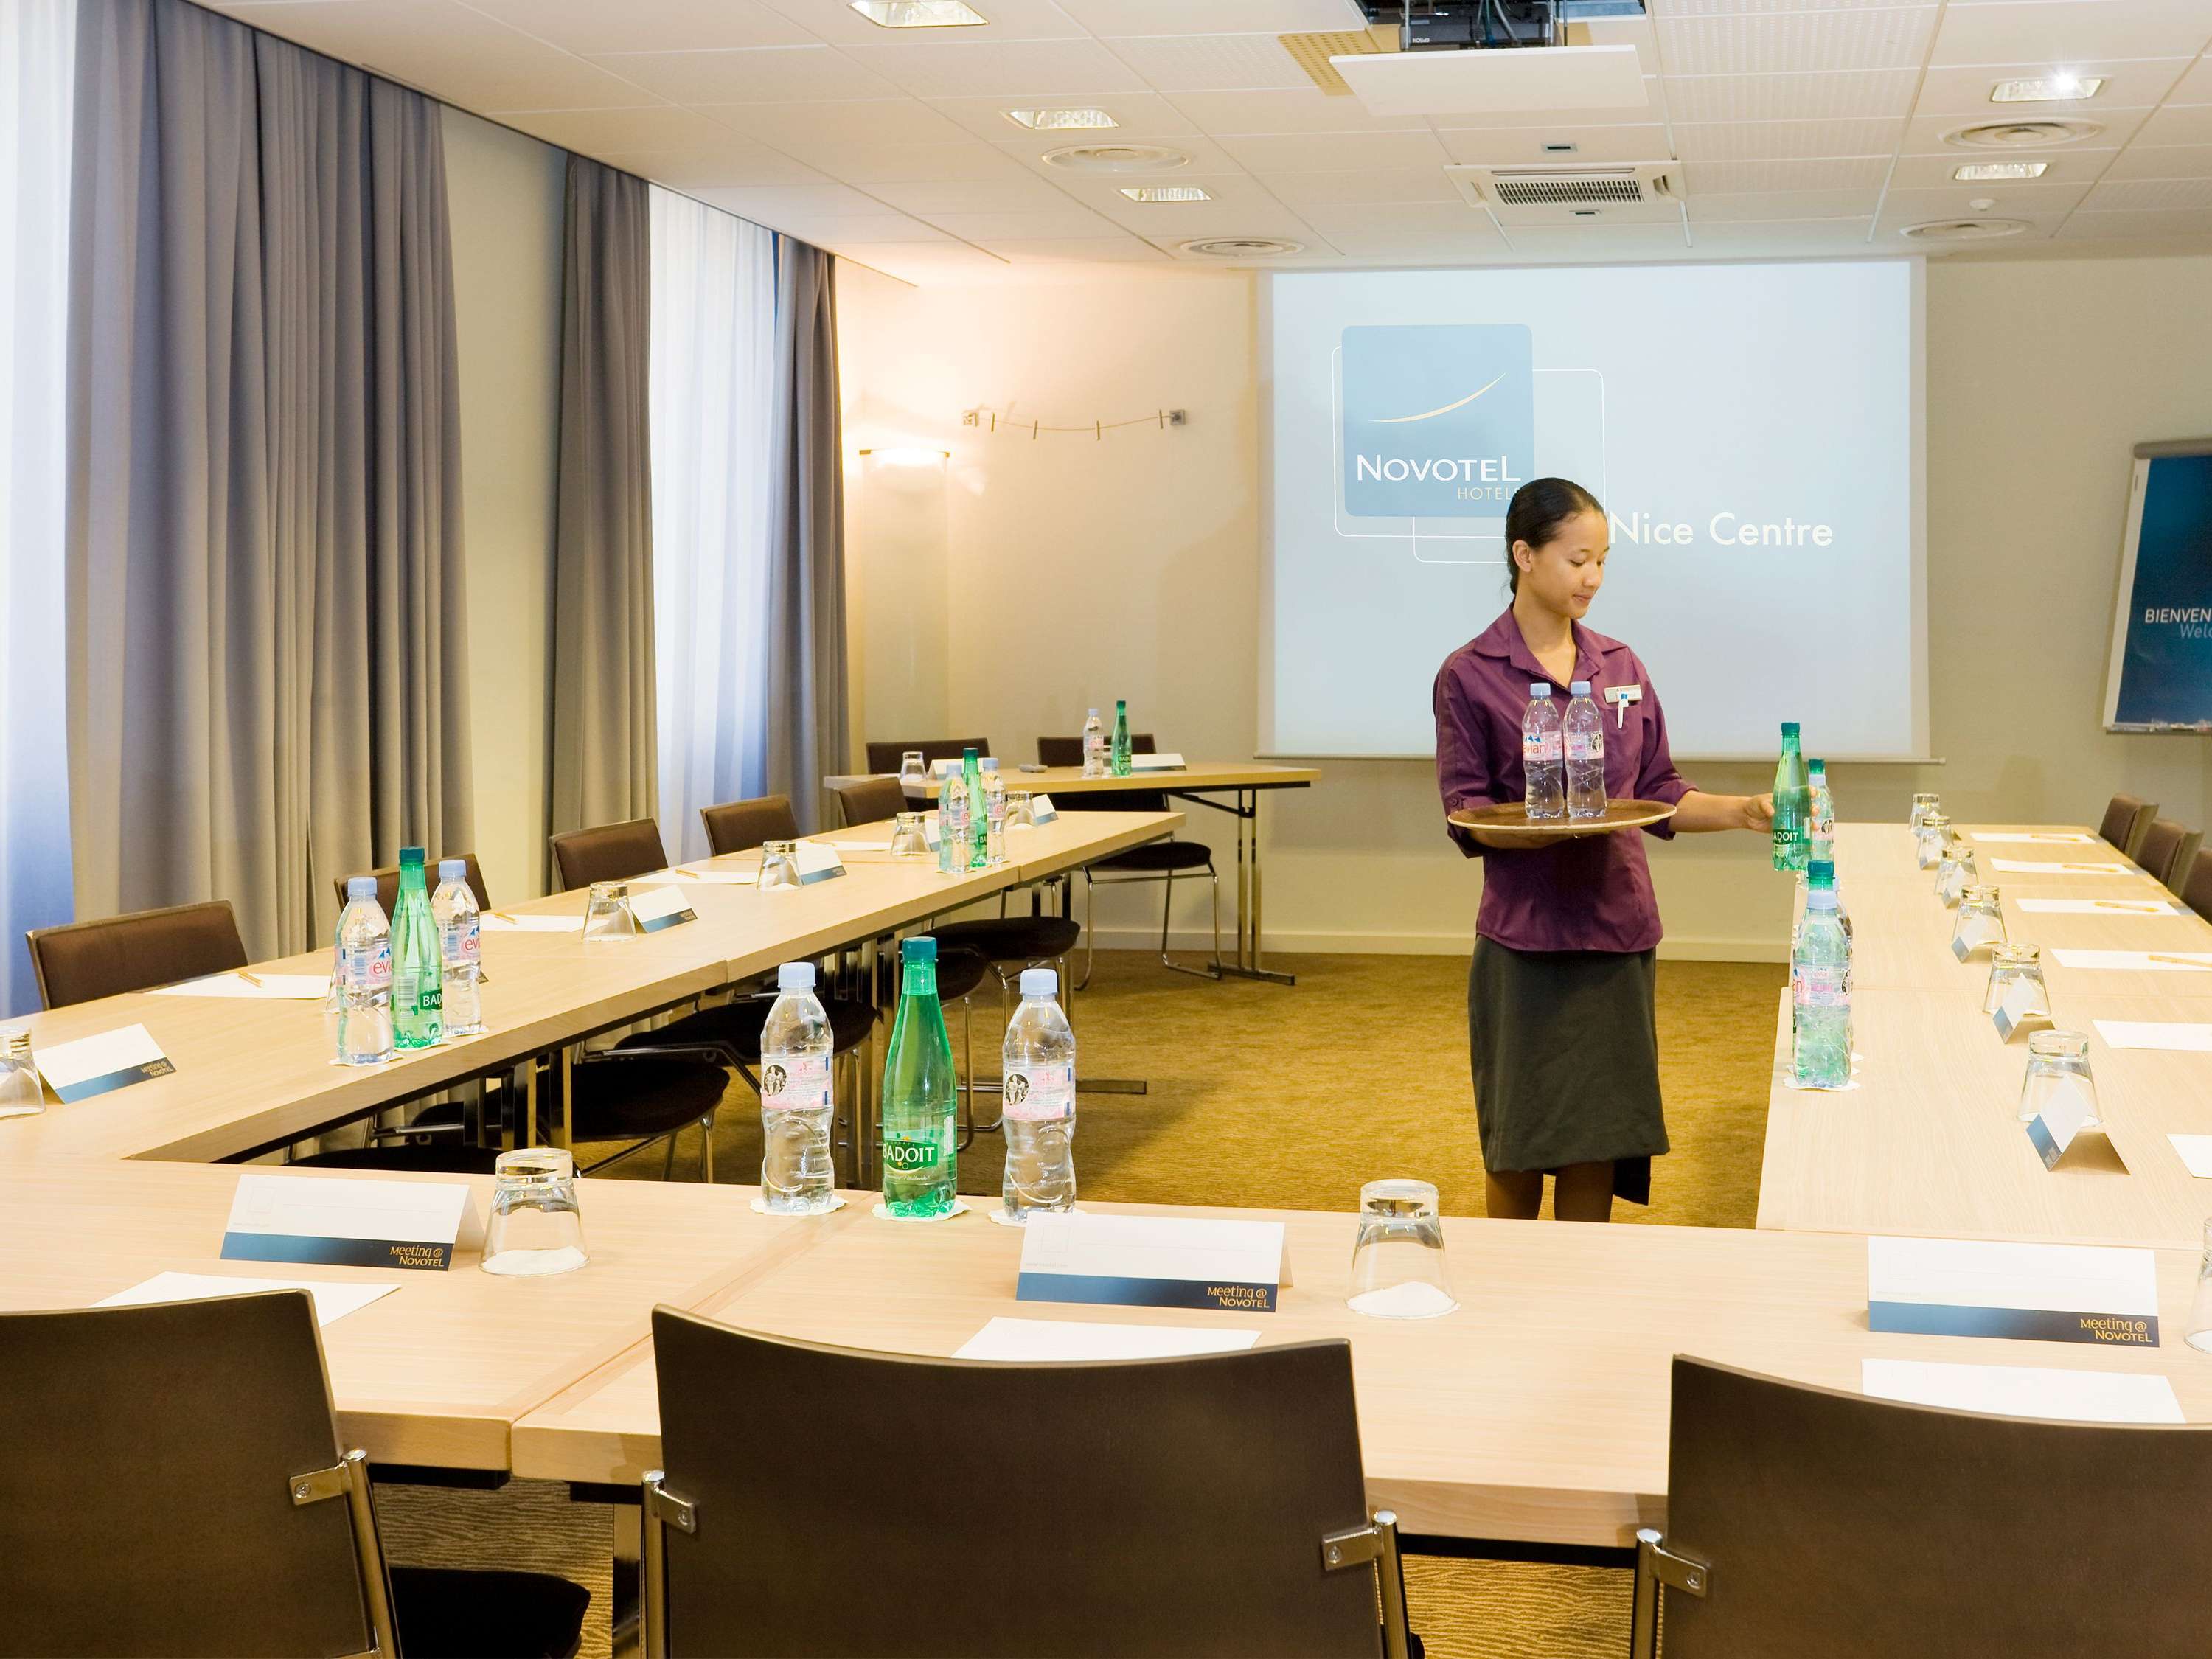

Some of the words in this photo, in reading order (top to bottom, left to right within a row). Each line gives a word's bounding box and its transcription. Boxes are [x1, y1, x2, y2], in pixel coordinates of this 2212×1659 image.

[1357, 453, 1522, 481] NOVOTEL
[1609, 511, 1694, 545] Nice
[1709, 512, 1834, 546] Centre
[2145, 608, 2212, 623] BIENVEN
[2180, 623, 2212, 639] Welc
[1773, 832, 1799, 841] ADOIT
[422, 993, 442, 1006] BAD
[883, 1143, 935, 1163] BADOIT
[389, 1245, 431, 1258] Meeting
[399, 1256, 444, 1267] NOVOTEL
[1207, 1286, 1254, 1299] Meeting
[1219, 1297, 1270, 1308] NOVOTEL
[2080, 1318, 2132, 1332] Meeting
[2095, 1329, 2153, 1343] NOVOTEL
